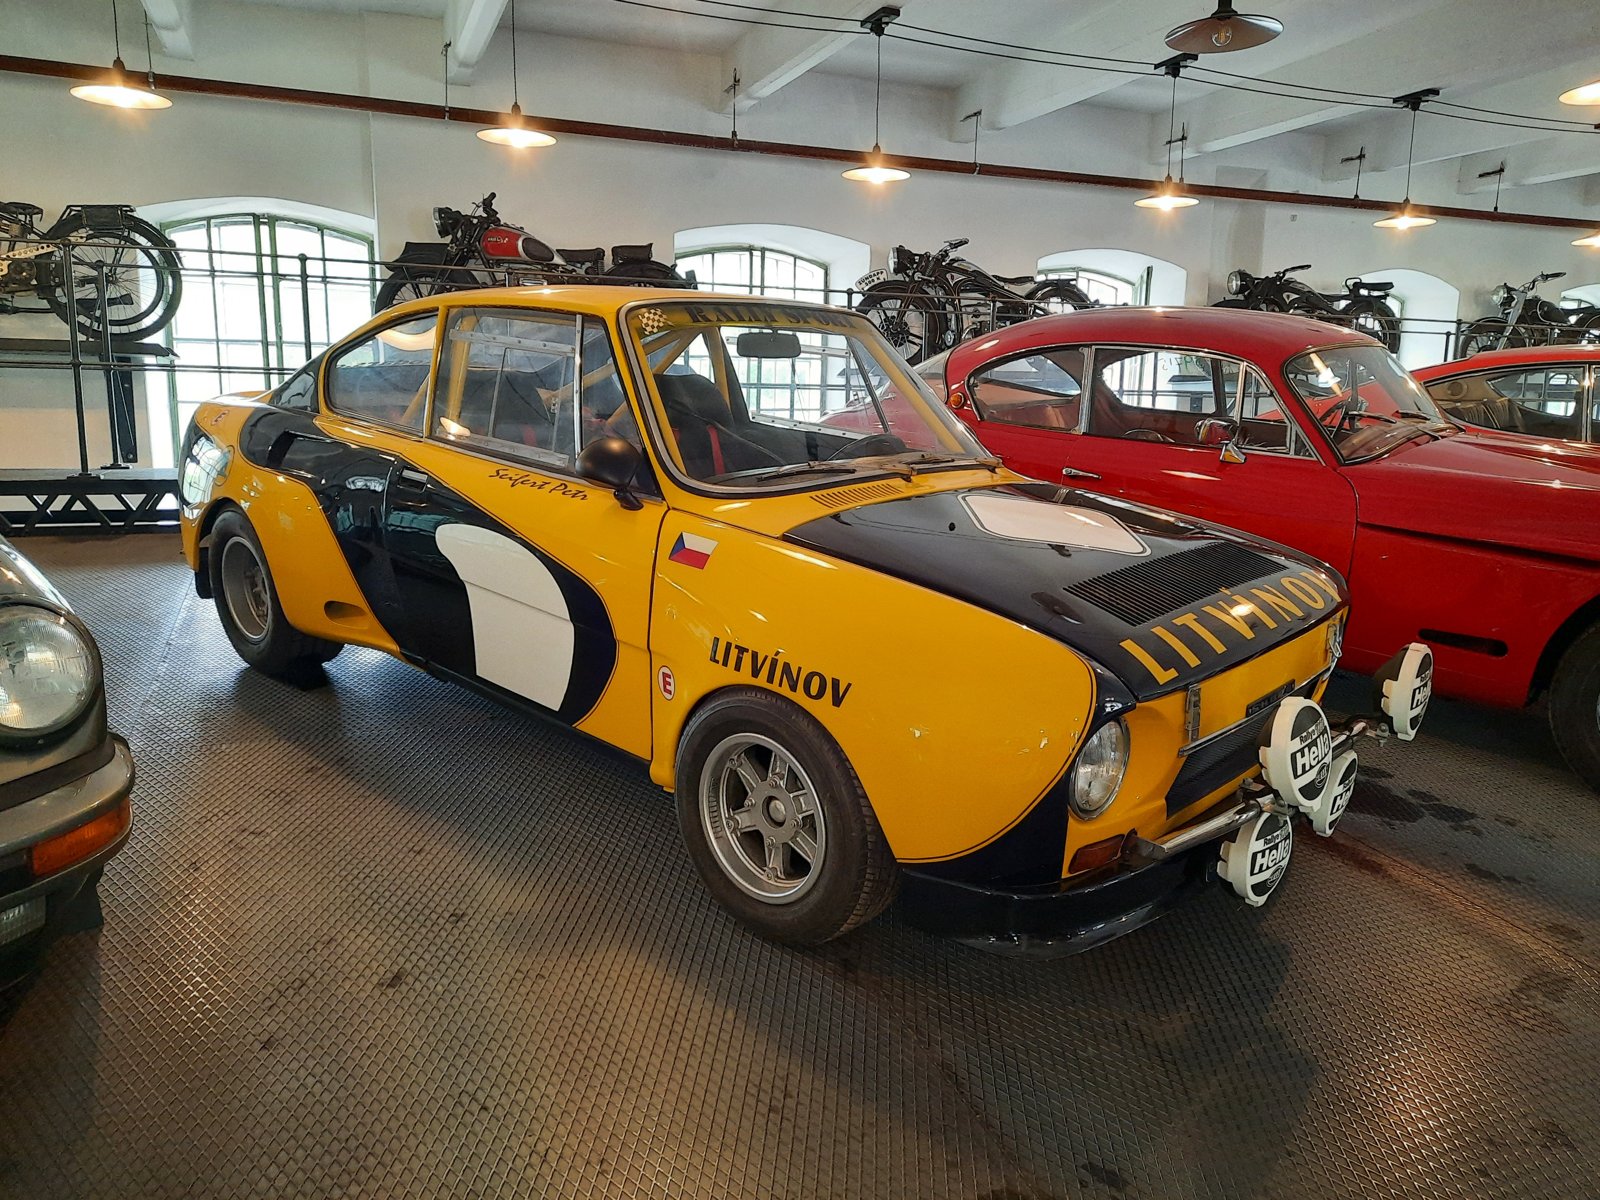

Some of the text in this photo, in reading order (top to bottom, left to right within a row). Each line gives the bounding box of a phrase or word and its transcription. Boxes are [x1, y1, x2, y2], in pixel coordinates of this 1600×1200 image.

[489, 468, 589, 501] Seifert Petr
[1119, 571, 1342, 685] LITVÍNOV
[661, 671, 672, 696] E
[709, 636, 852, 709] LITVÍNOV
[1295, 733, 1329, 776] Hella
[1253, 839, 1290, 874] Hella
